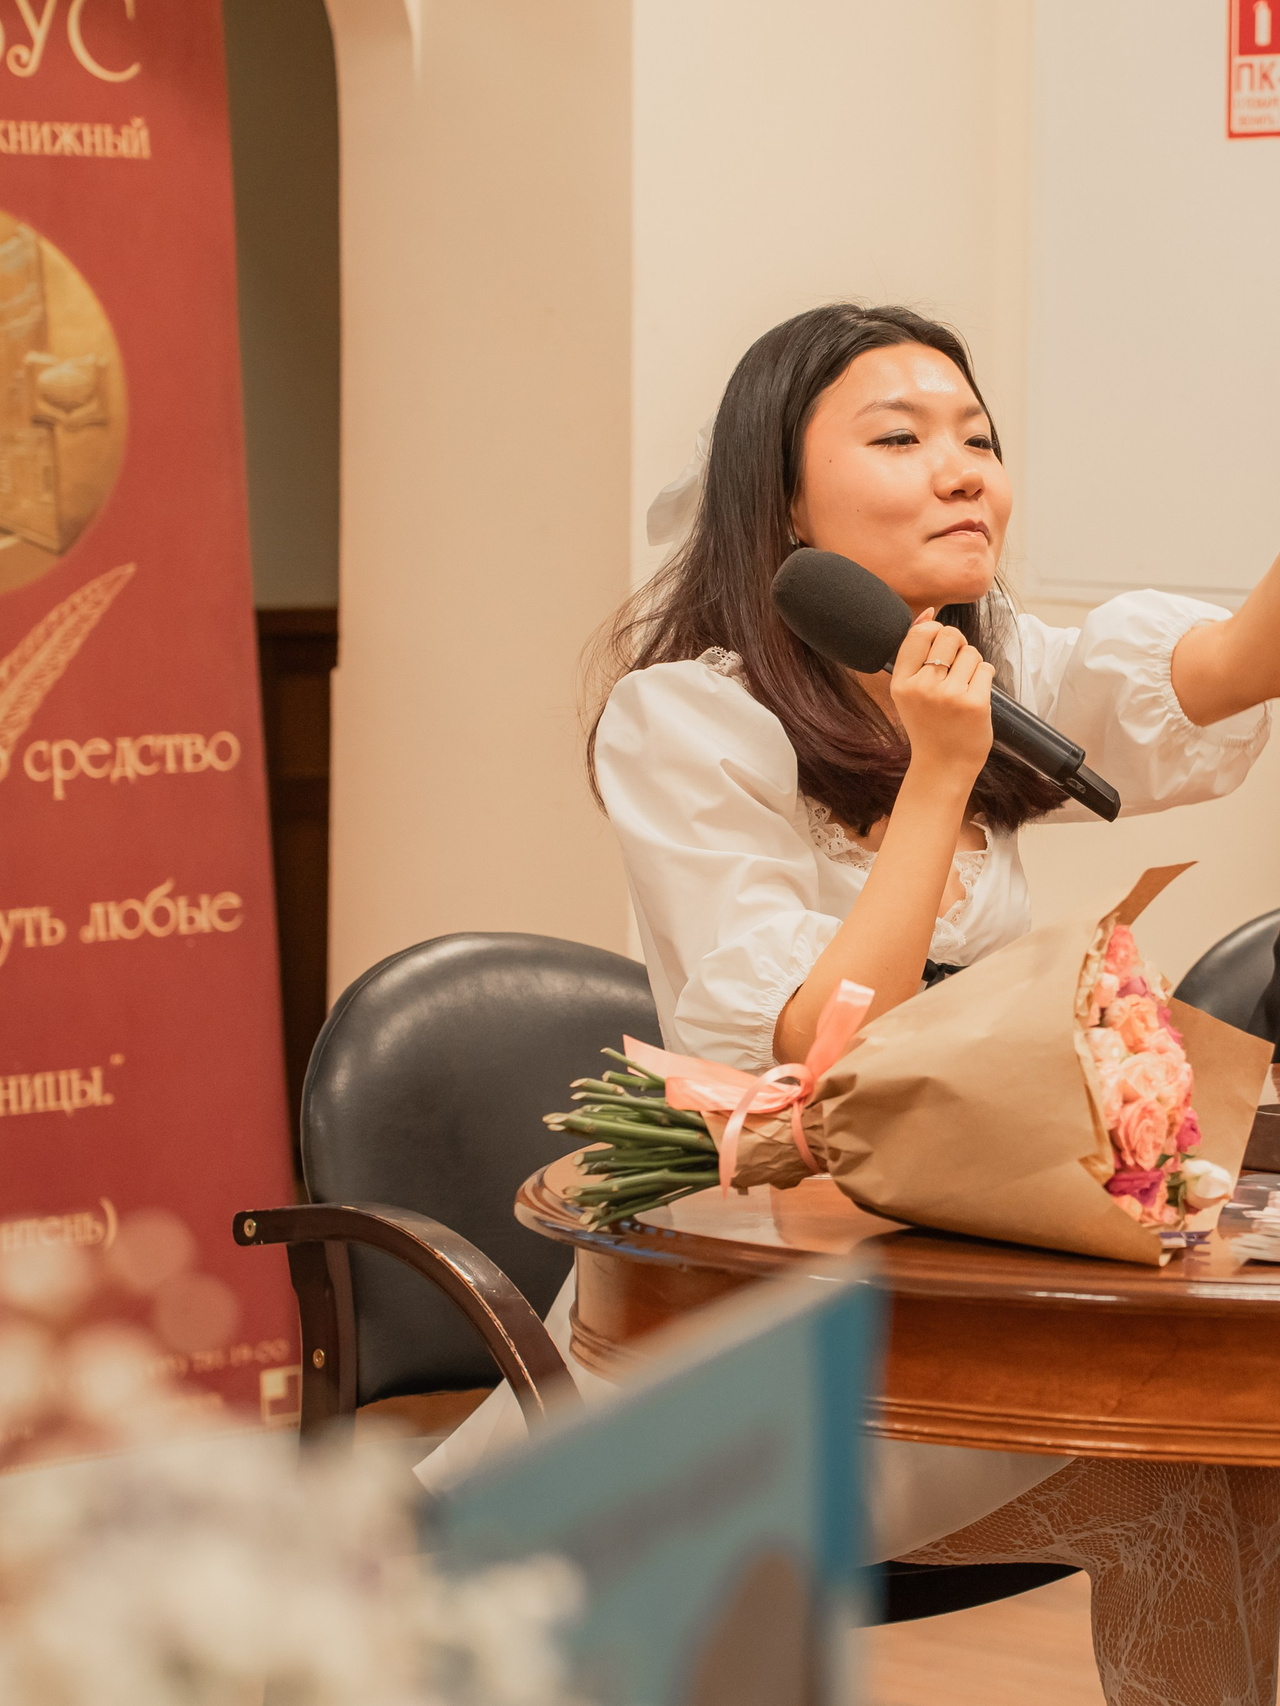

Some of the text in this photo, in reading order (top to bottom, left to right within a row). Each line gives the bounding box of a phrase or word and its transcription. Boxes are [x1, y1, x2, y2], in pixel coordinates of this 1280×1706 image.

[0, 0, 142, 82] УС
[23, 731, 241, 800] средство
[79, 877, 244, 943] любые
